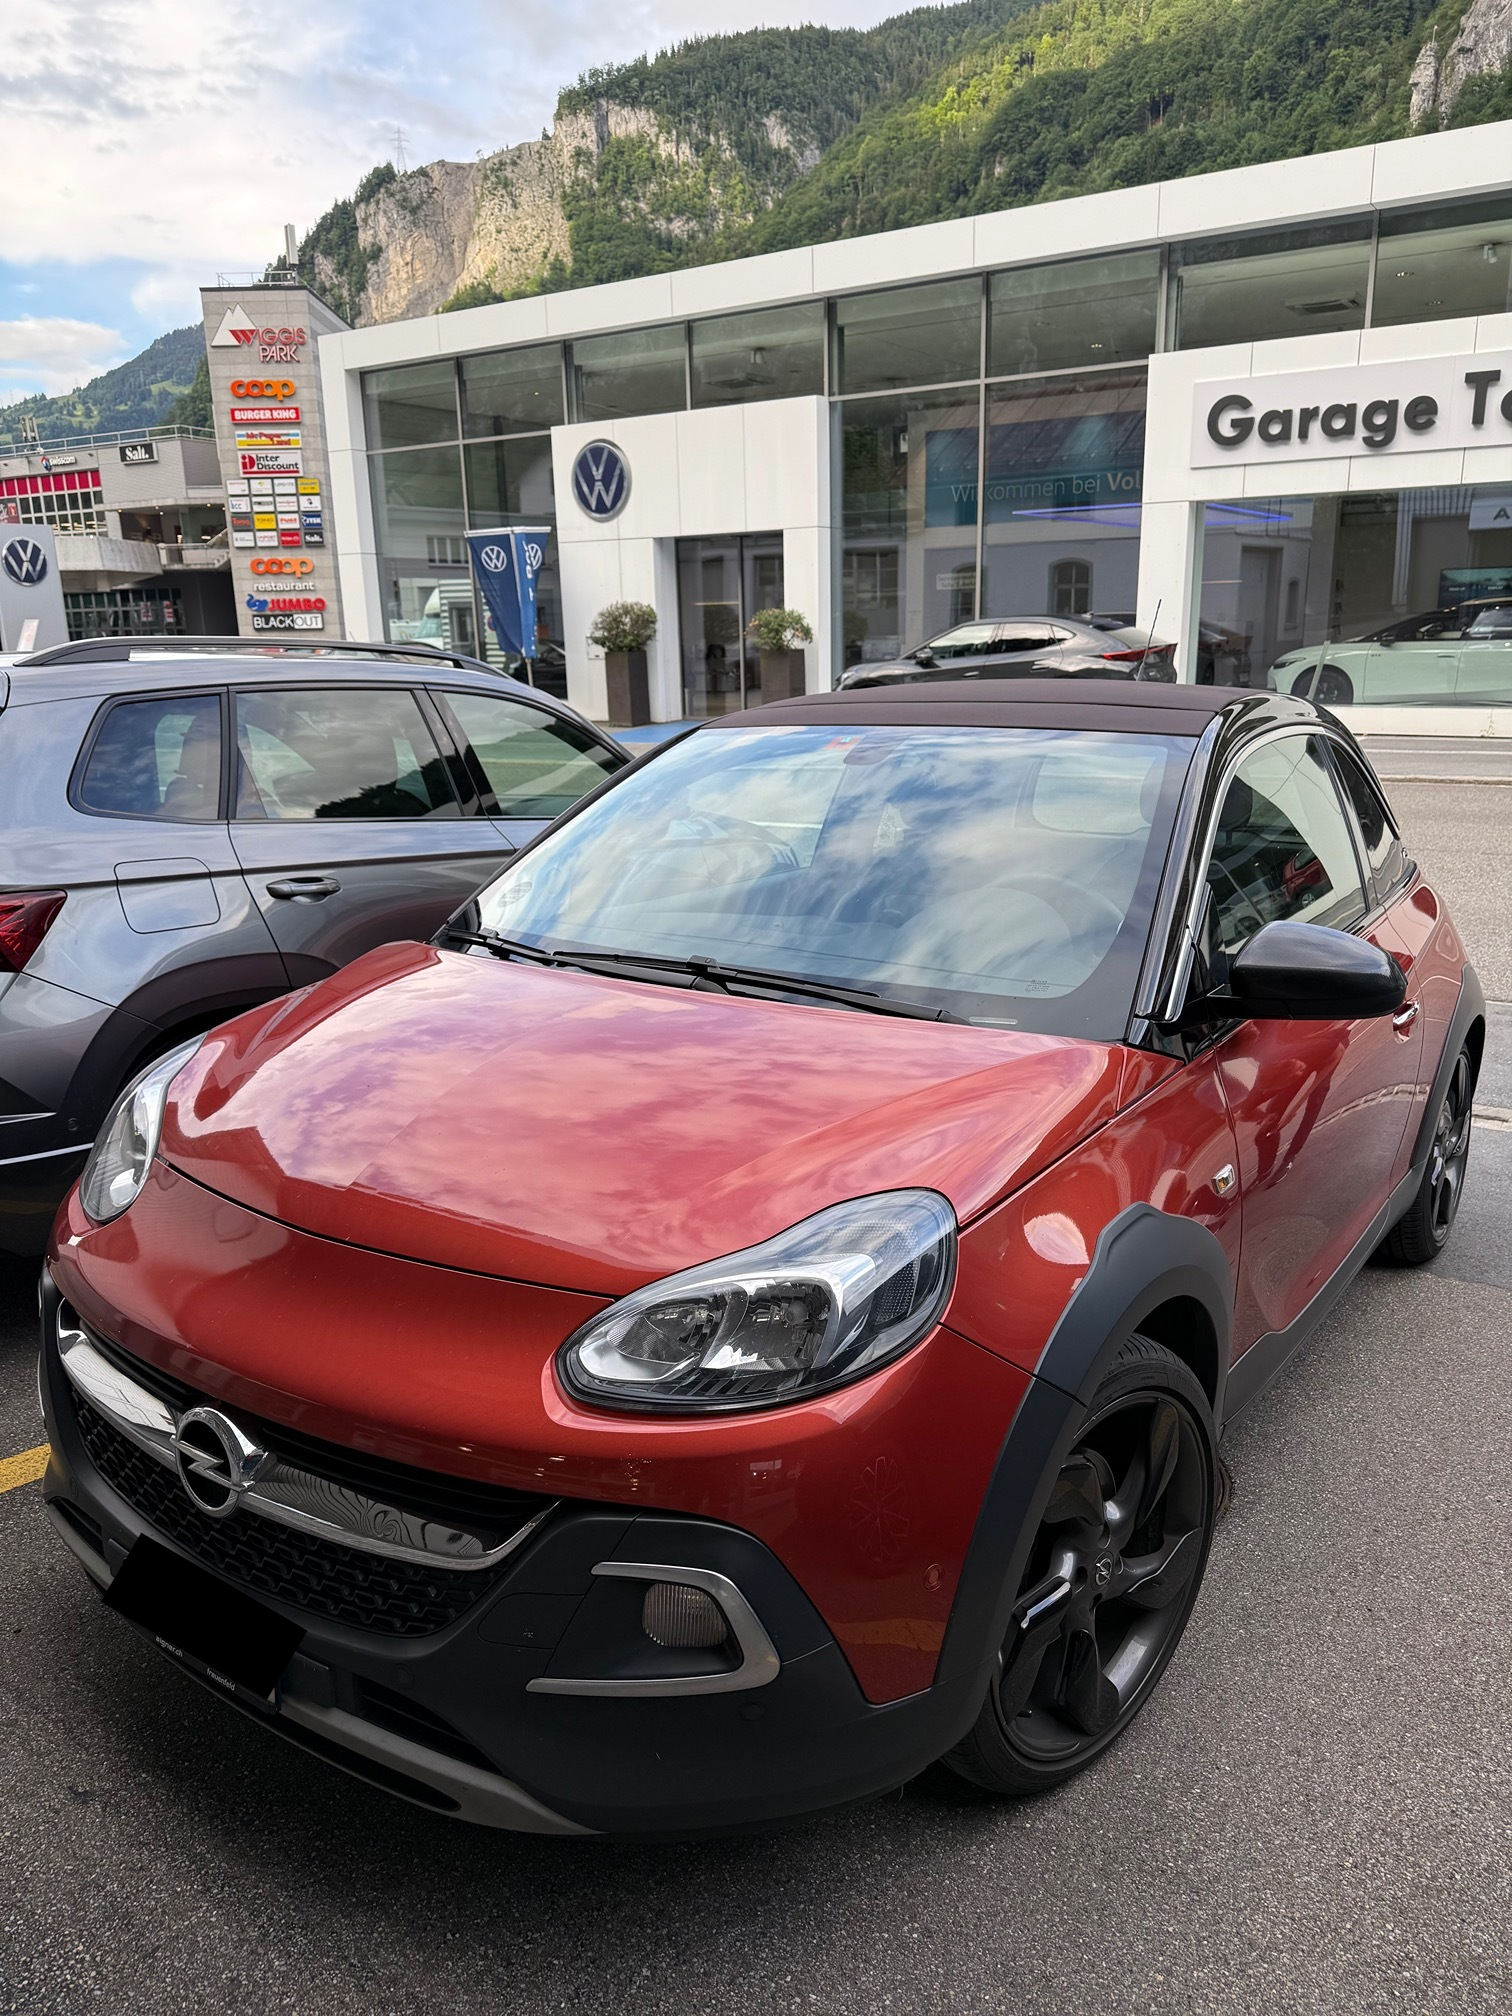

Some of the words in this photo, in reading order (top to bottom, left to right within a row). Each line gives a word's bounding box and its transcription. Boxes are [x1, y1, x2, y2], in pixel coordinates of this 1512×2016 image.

[259, 345, 300, 362] PARK
[230, 380, 295, 401] coop
[234, 410, 271, 420] BURGER
[272, 409, 297, 419] KING
[1207, 394, 1438, 448] Garage
[1464, 369, 1512, 425] T
[49, 456, 76, 466] swisscom
[256, 454, 279, 462] Inter
[256, 462, 299, 470] Discount
[1072, 474, 1100, 494] bei
[250, 557, 314, 579] coop
[254, 581, 315, 591] restaurant
[268, 597, 326, 612] JUMBO
[254, 615, 320, 629] BLACKOUT
[206, 1668, 236, 1691] frauenfeld
